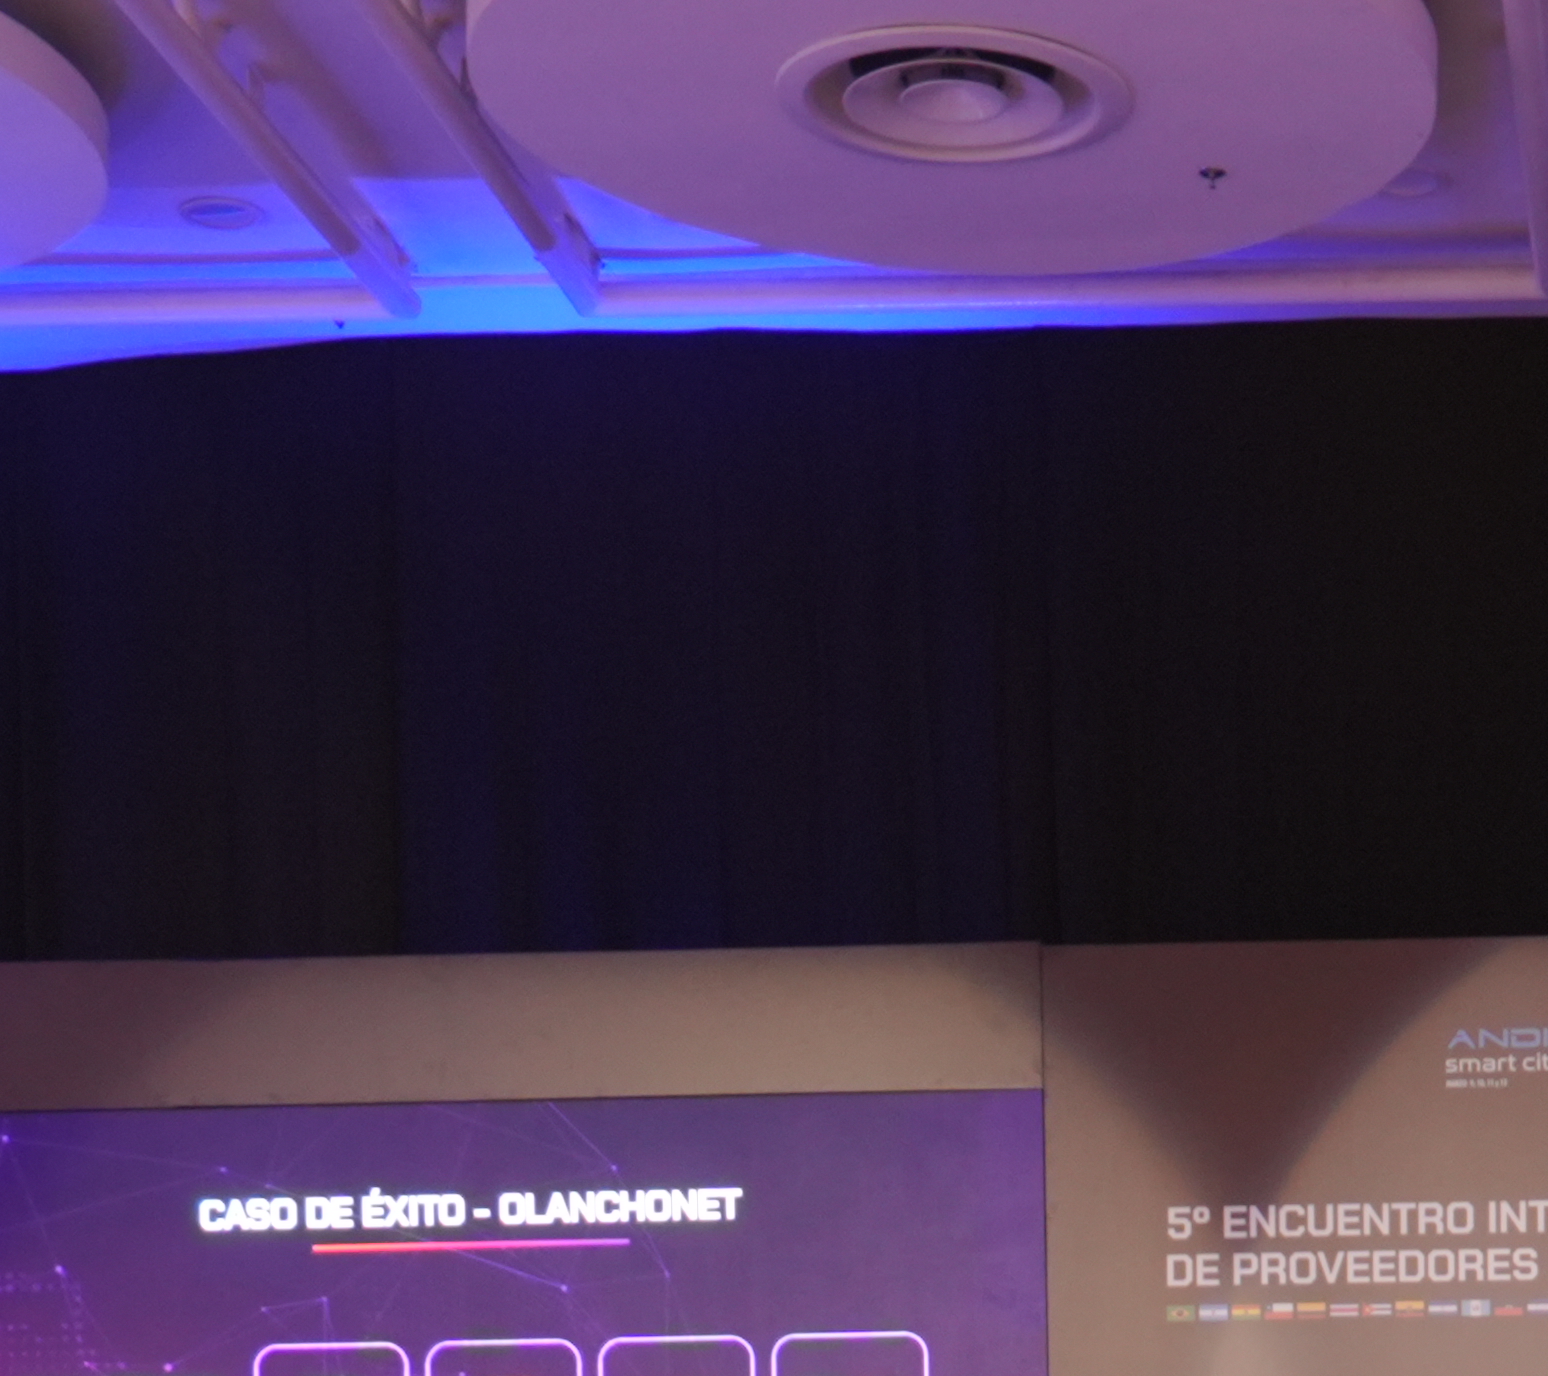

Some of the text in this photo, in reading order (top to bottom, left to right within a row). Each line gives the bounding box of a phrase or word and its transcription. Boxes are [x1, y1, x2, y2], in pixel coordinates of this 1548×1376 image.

[1445, 1054, 1516, 1073] smart
[198, 1186, 743, 1232] CASO DE ÉXITO OLANCHONET
[1223, 1201, 1474, 1239] ENCUENTRO
[1166, 1253, 1220, 1287] DE
[1232, 1247, 1538, 1286] PROVEEDORES
